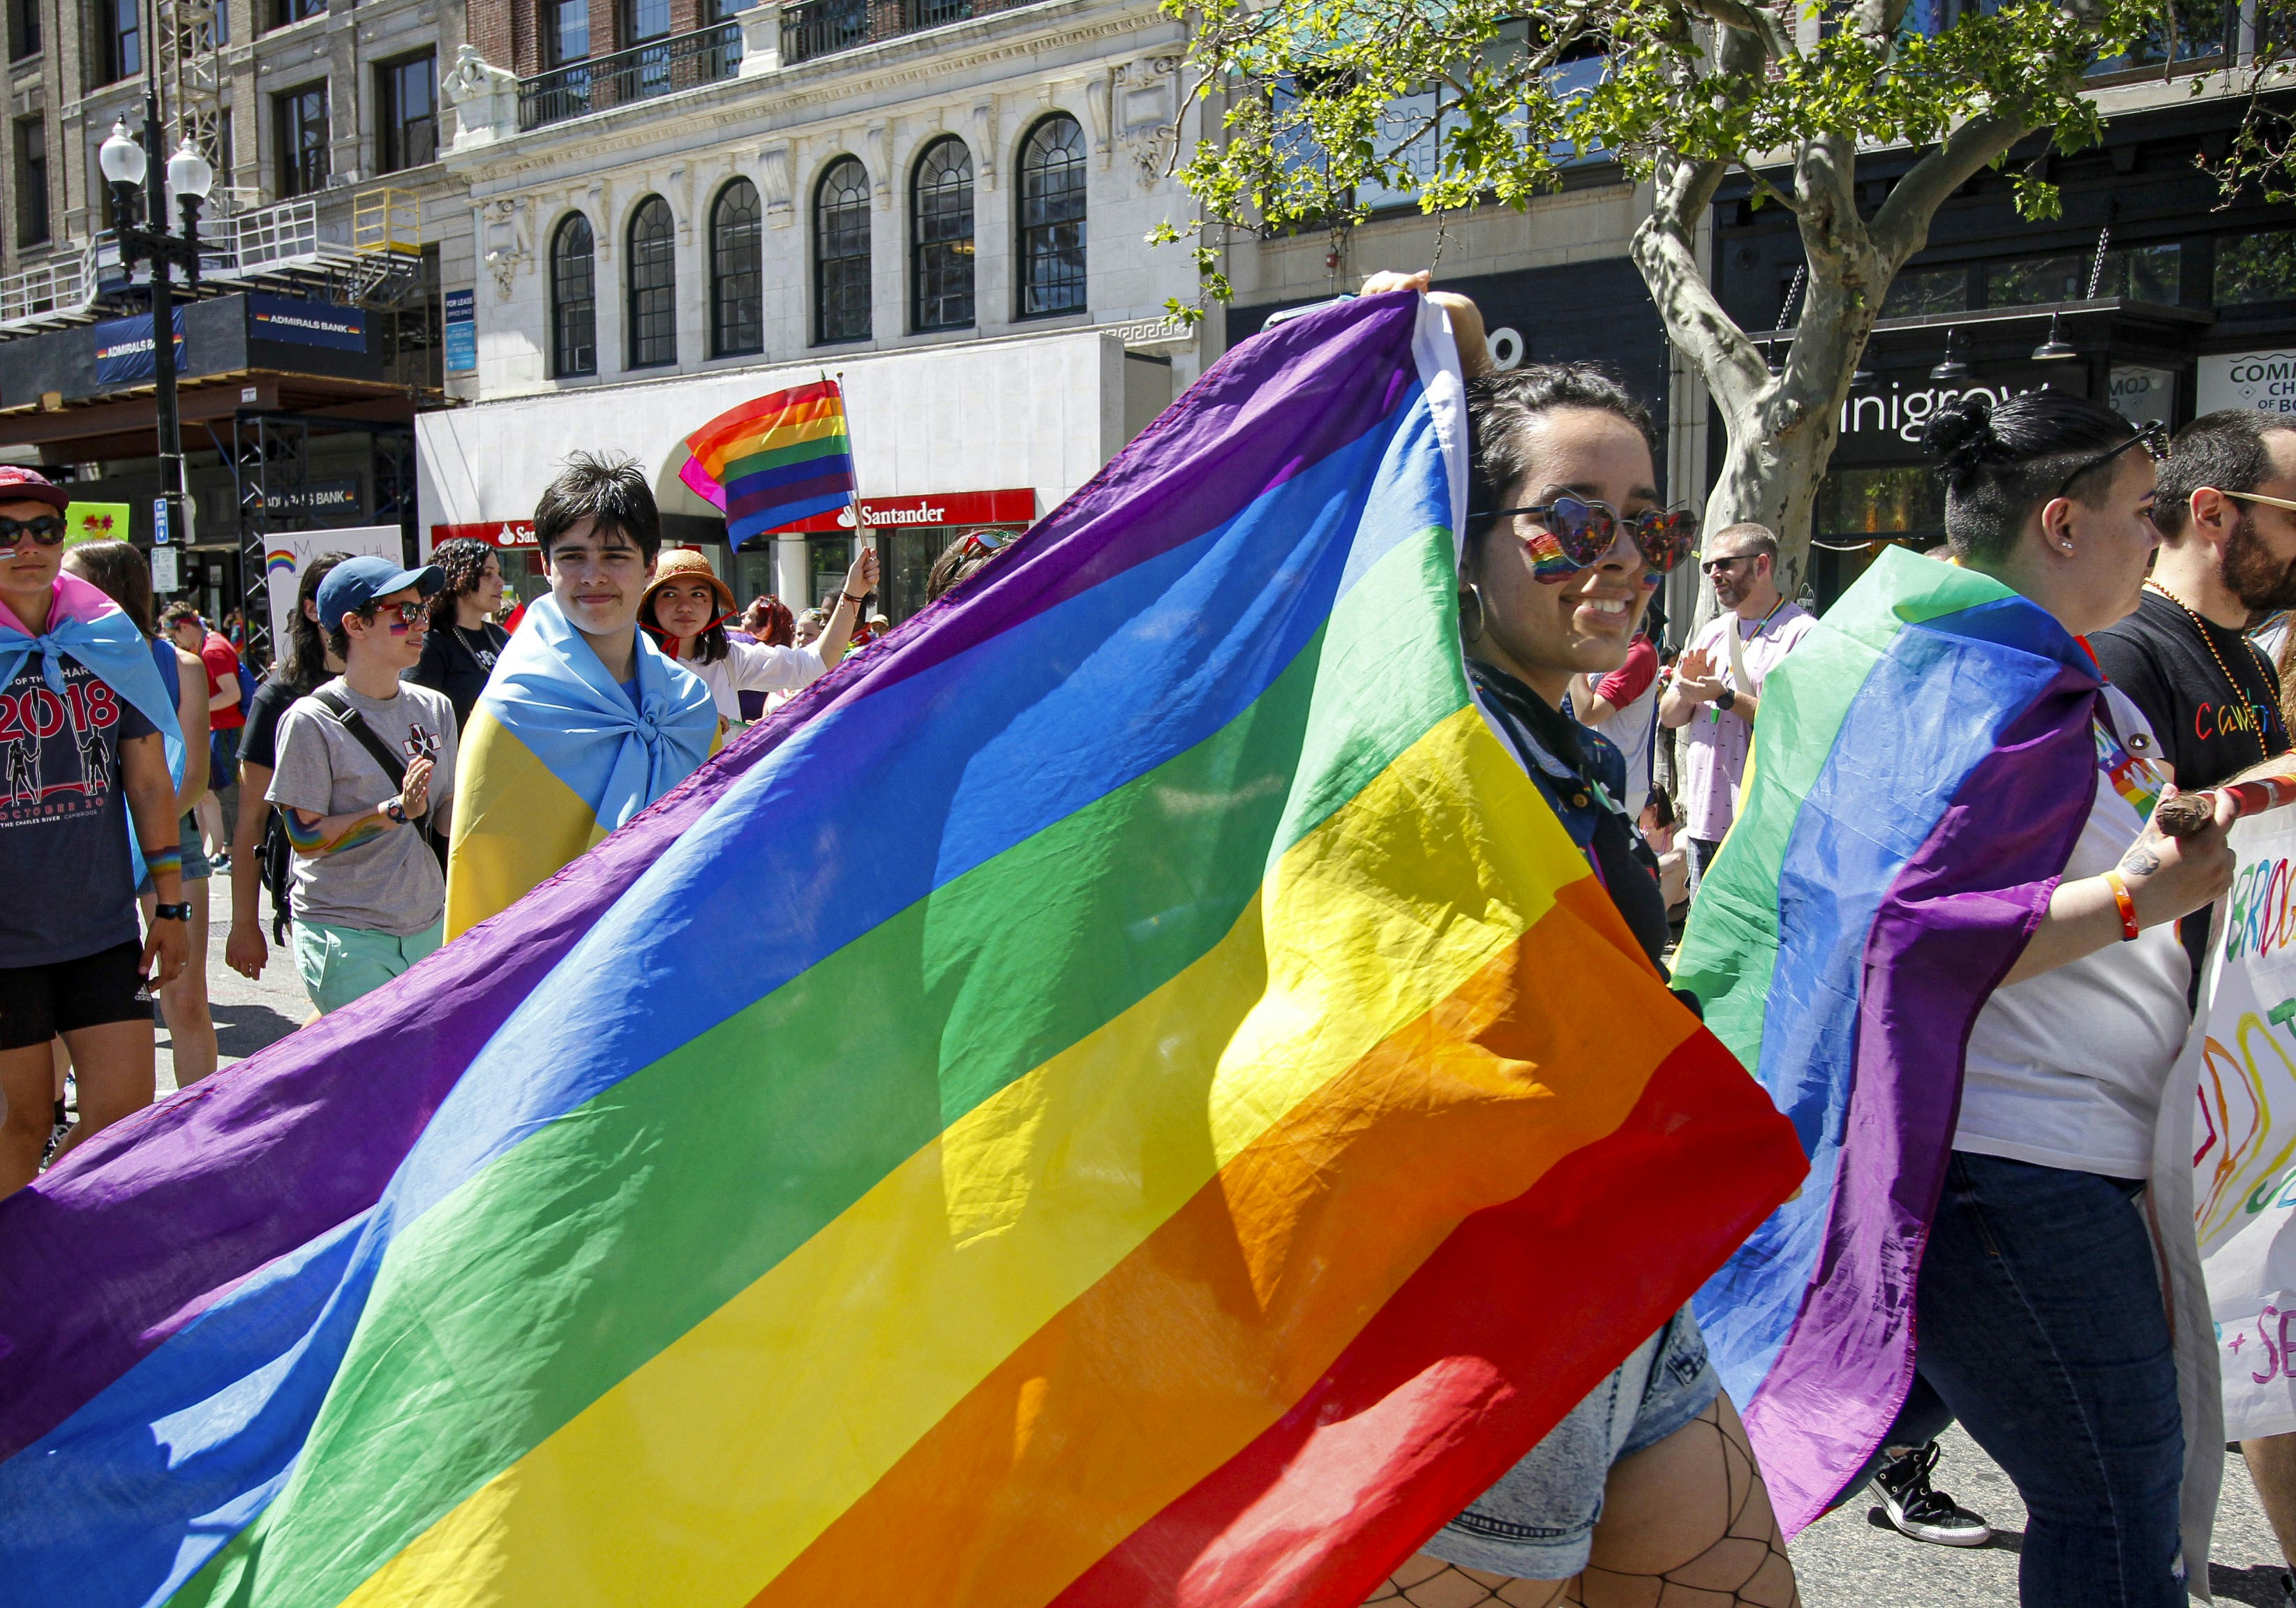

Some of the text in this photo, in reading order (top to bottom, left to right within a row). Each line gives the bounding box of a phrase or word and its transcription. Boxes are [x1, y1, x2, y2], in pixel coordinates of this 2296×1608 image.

[457, 297, 473, 306] LEASE
[270, 315, 348, 334] ADMIRALS BANK
[107, 340, 147, 359] ADMIRALS
[2230, 362, 2296, 383] COM
[2269, 381, 2296, 396] CH
[2258, 399, 2275, 410] OF
[316, 491, 344, 505] BANK
[862, 500, 945, 526] Santander
[15, 677, 27, 685] OF
[29, 675, 44, 684] TH
[0, 679, 120, 743] 2018
[0, 802, 76, 821] OCTOBER
[15, 818, 40, 826] CHARLES
[64, 808, 98, 820] CAMBRIDGE
